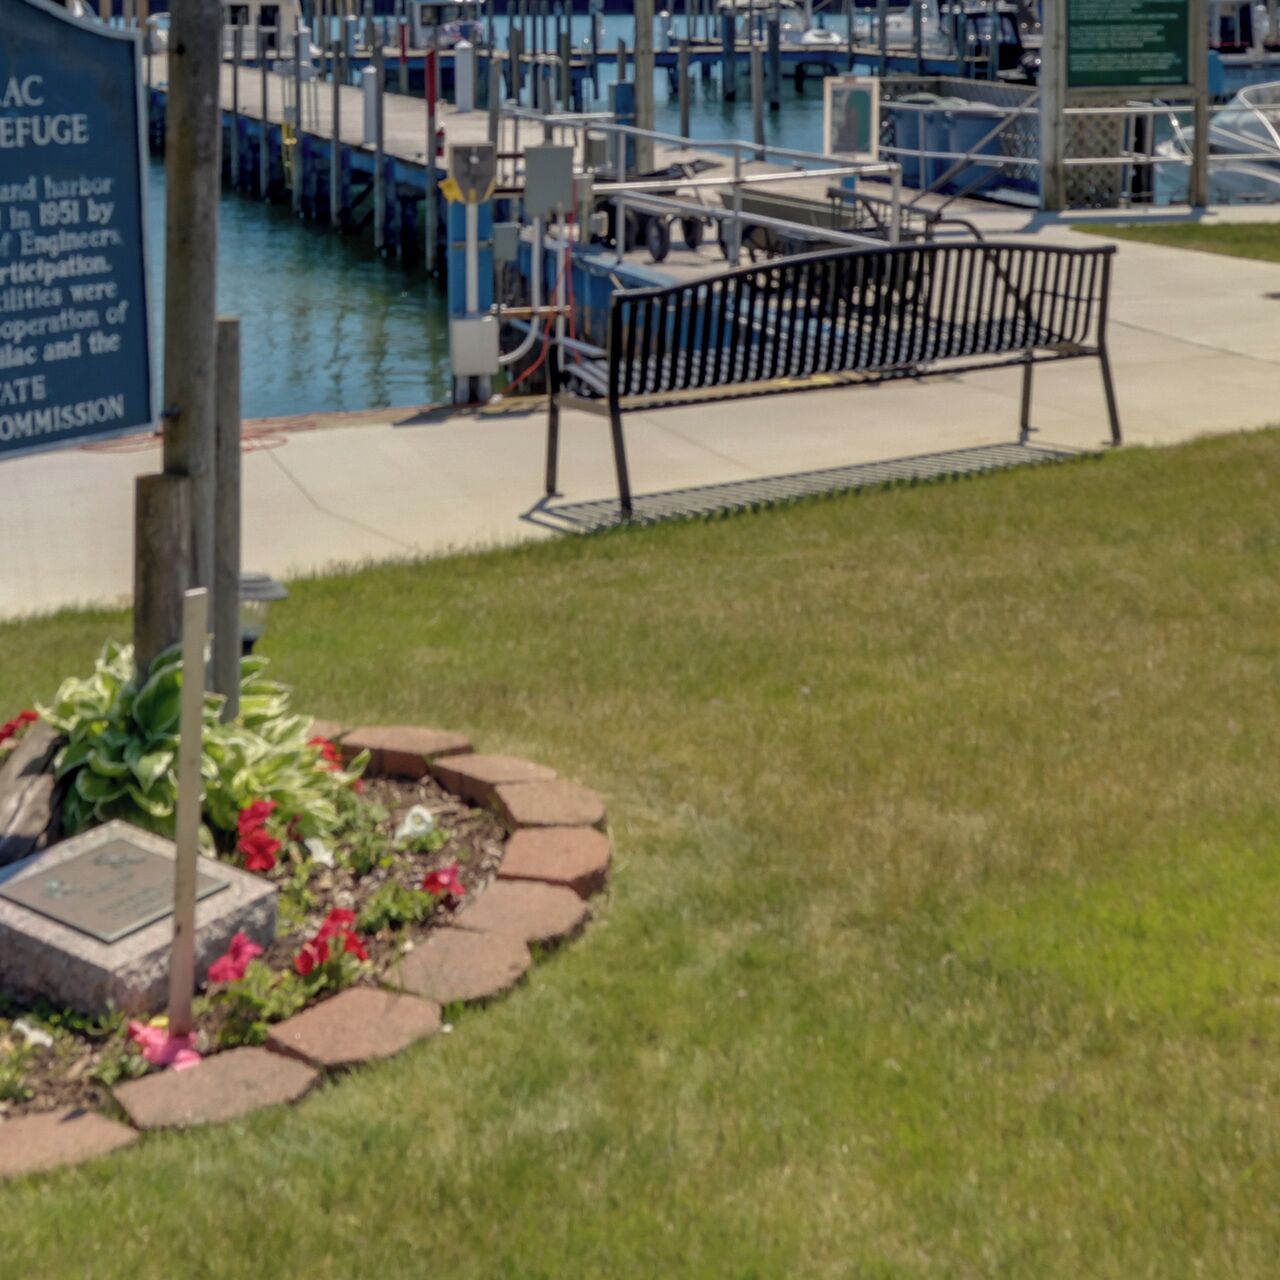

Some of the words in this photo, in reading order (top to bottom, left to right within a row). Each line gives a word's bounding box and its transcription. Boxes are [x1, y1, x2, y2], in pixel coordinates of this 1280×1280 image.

[43, 173, 114, 199] harbor
[10, 206, 31, 230] in
[38, 200, 80, 226] 1951
[87, 198, 115, 224] by
[70, 281, 117, 303] were
[105, 299, 129, 324] of
[42, 332, 82, 362] and
[87, 330, 122, 355] the
